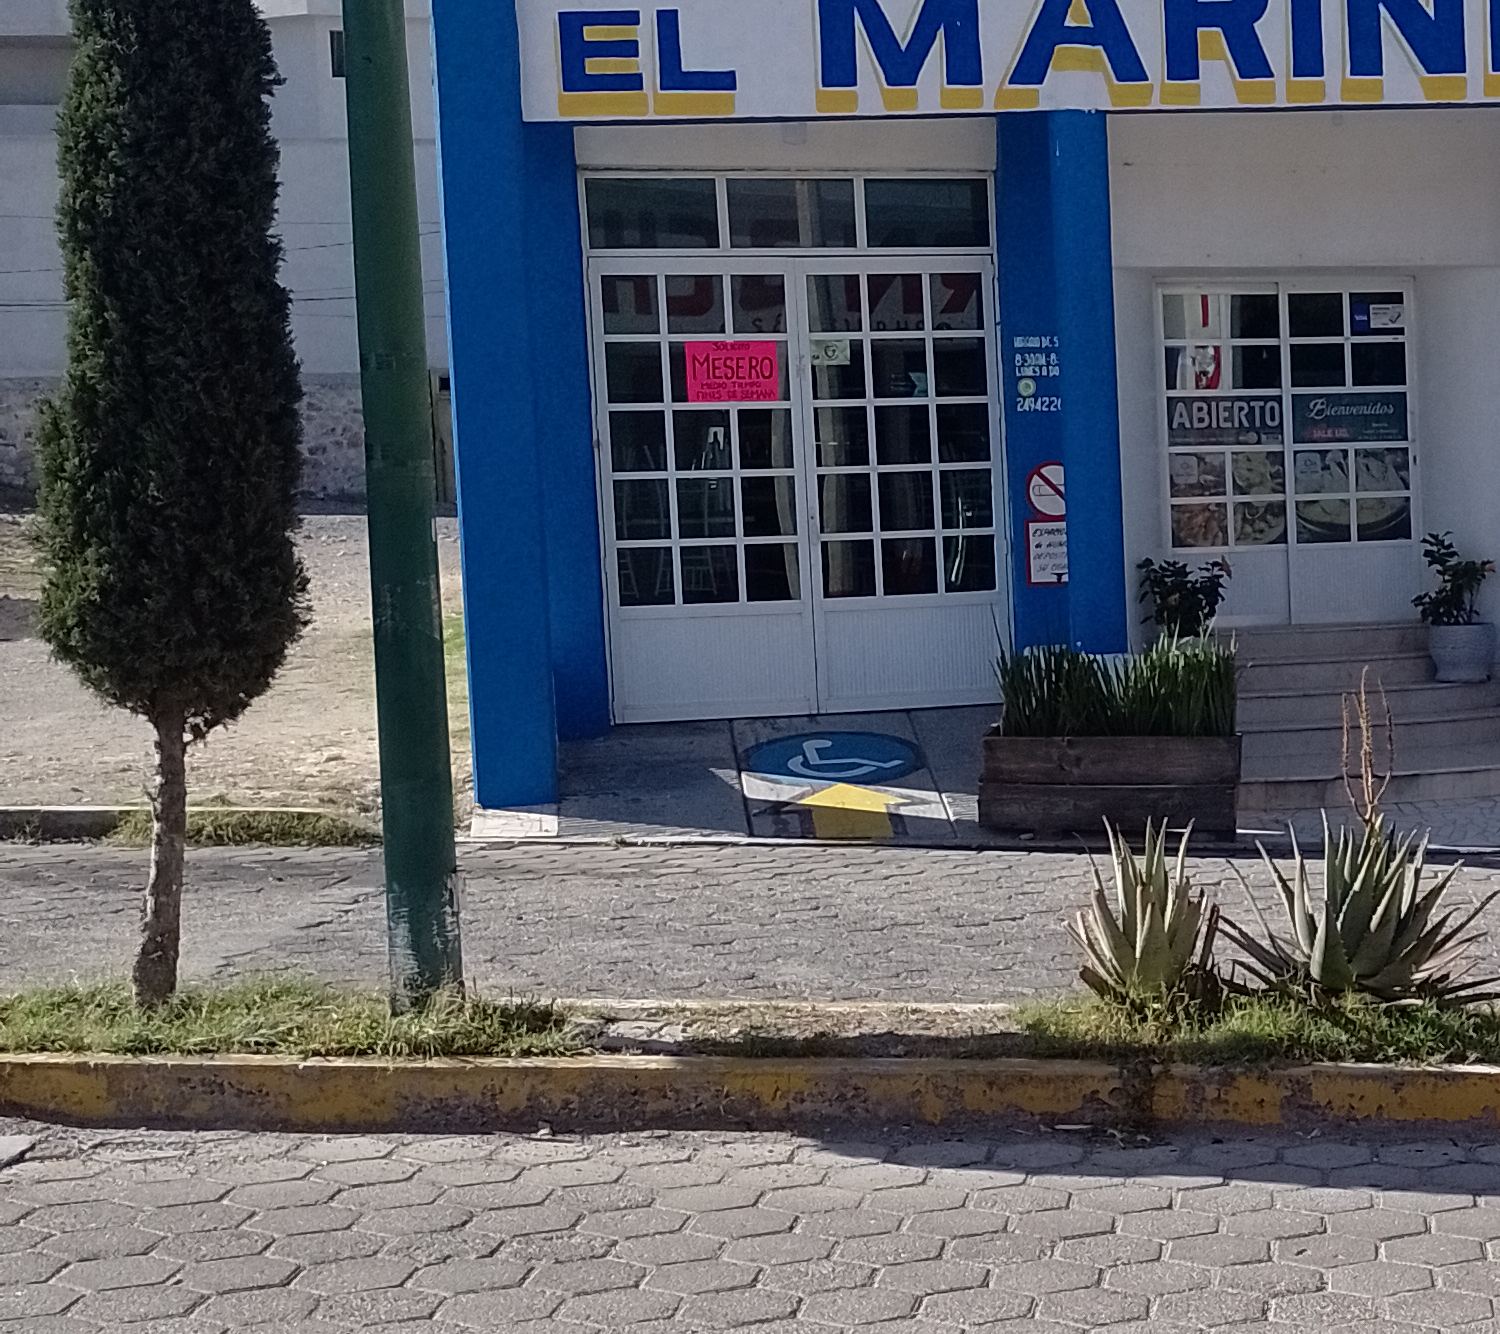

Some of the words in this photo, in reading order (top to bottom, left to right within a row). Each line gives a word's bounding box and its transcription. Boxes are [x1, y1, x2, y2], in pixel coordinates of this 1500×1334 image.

[556, 9, 737, 117] EL
[692, 353, 774, 381] MESERO
[741, 389, 776, 399] SEMANA
[1305, 396, 1395, 420] Bienvenidos
[1171, 400, 1281, 429] ABIERTO
